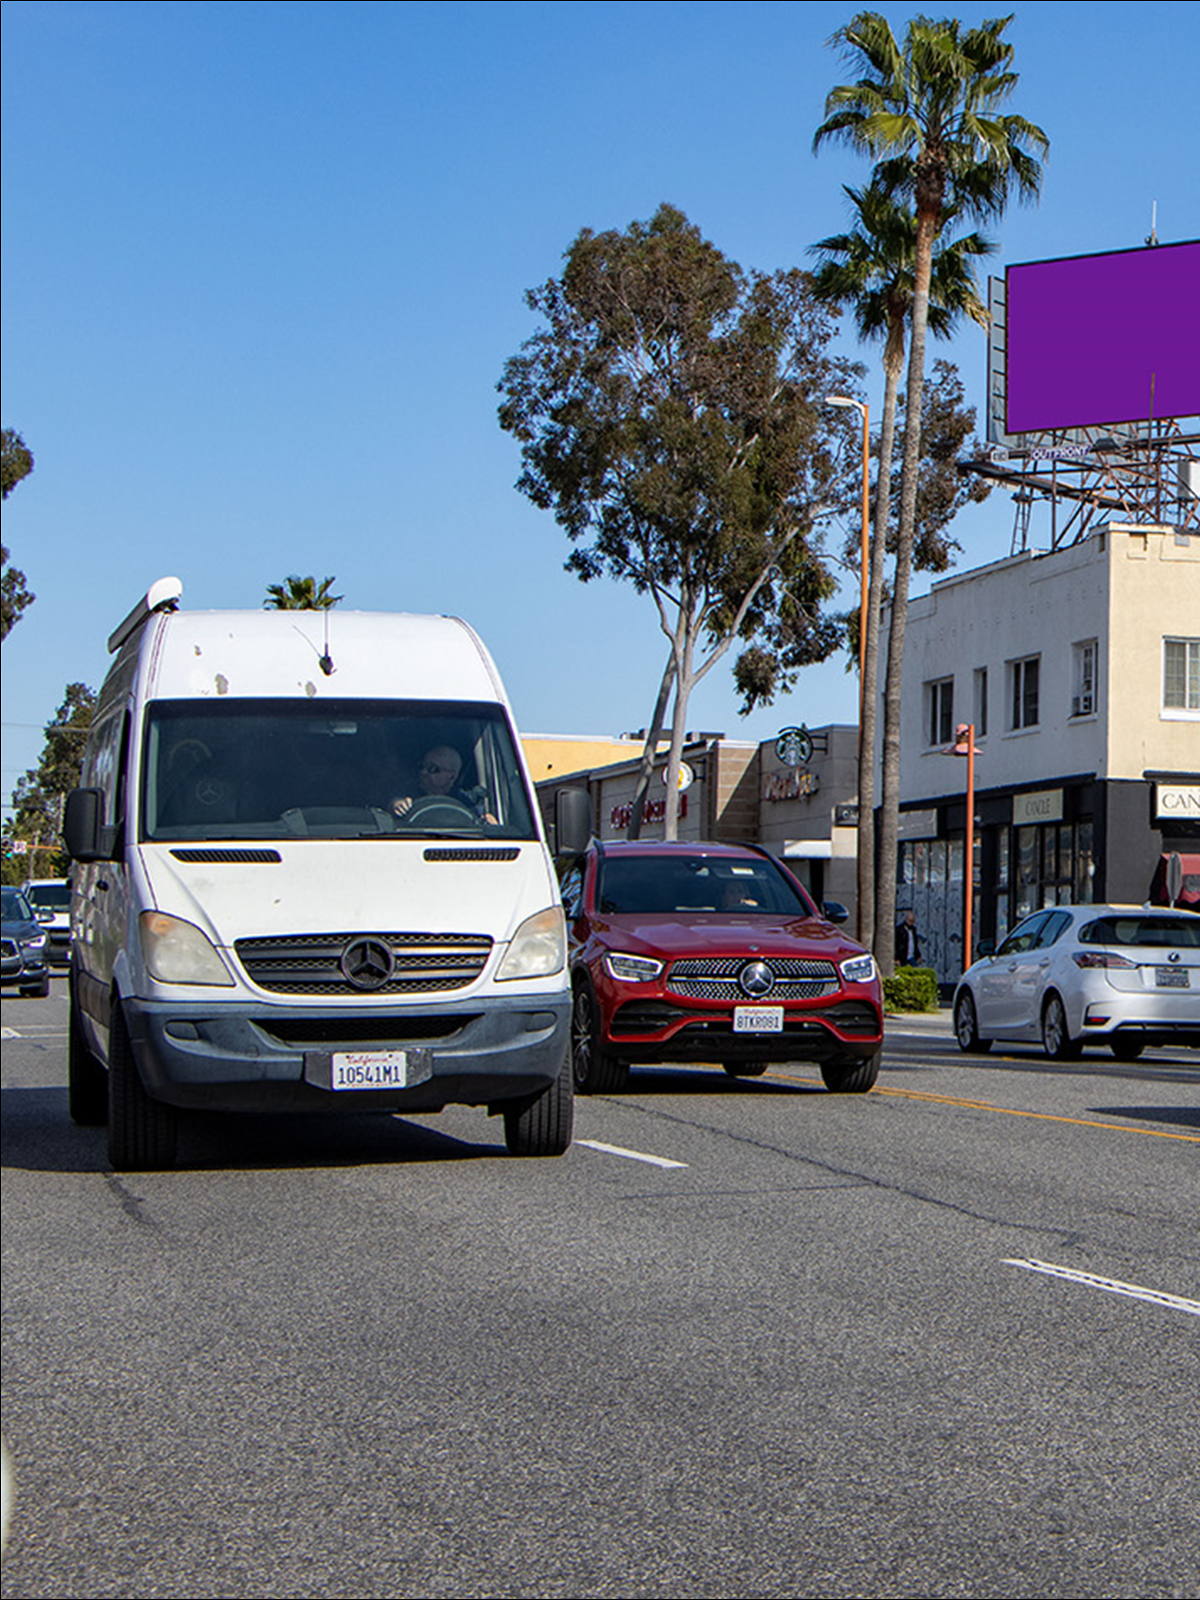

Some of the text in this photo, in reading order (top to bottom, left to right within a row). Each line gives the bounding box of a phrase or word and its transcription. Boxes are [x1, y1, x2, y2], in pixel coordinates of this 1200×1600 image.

[1031, 446, 1090, 460] OUTFRONT
[1025, 799, 1051, 816] CANDLE
[338, 1065, 401, 1085] 10541M1
